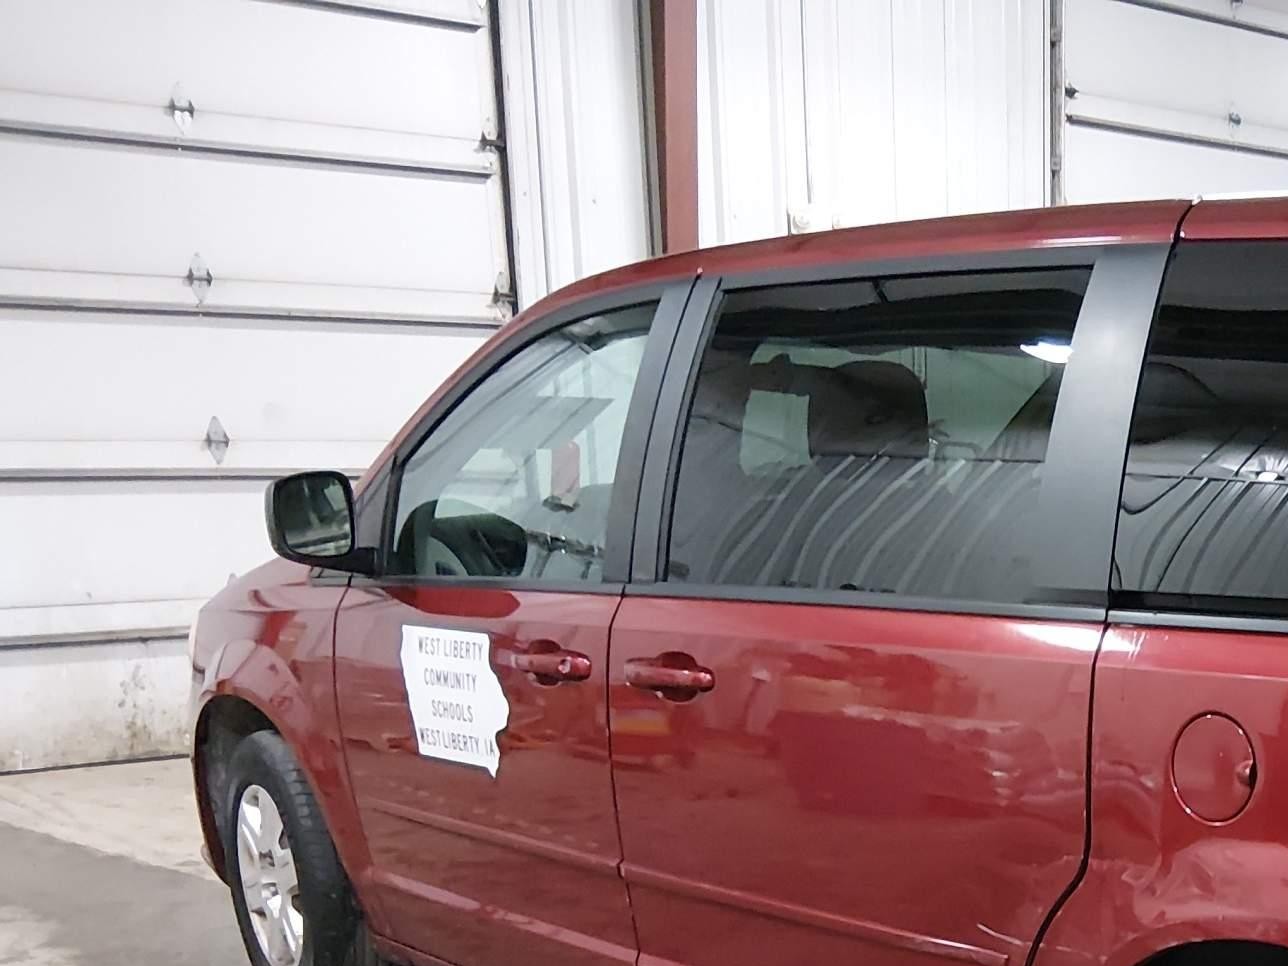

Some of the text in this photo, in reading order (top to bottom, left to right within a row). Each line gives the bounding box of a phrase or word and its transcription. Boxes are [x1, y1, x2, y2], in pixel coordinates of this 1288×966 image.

[418, 637, 484, 661] WEST LIBERTY
[424, 668, 477, 692] COMMUNITY
[431, 700, 474, 723] SCHOOLS
[419, 727, 496, 758] WEST LIBERTY IA
